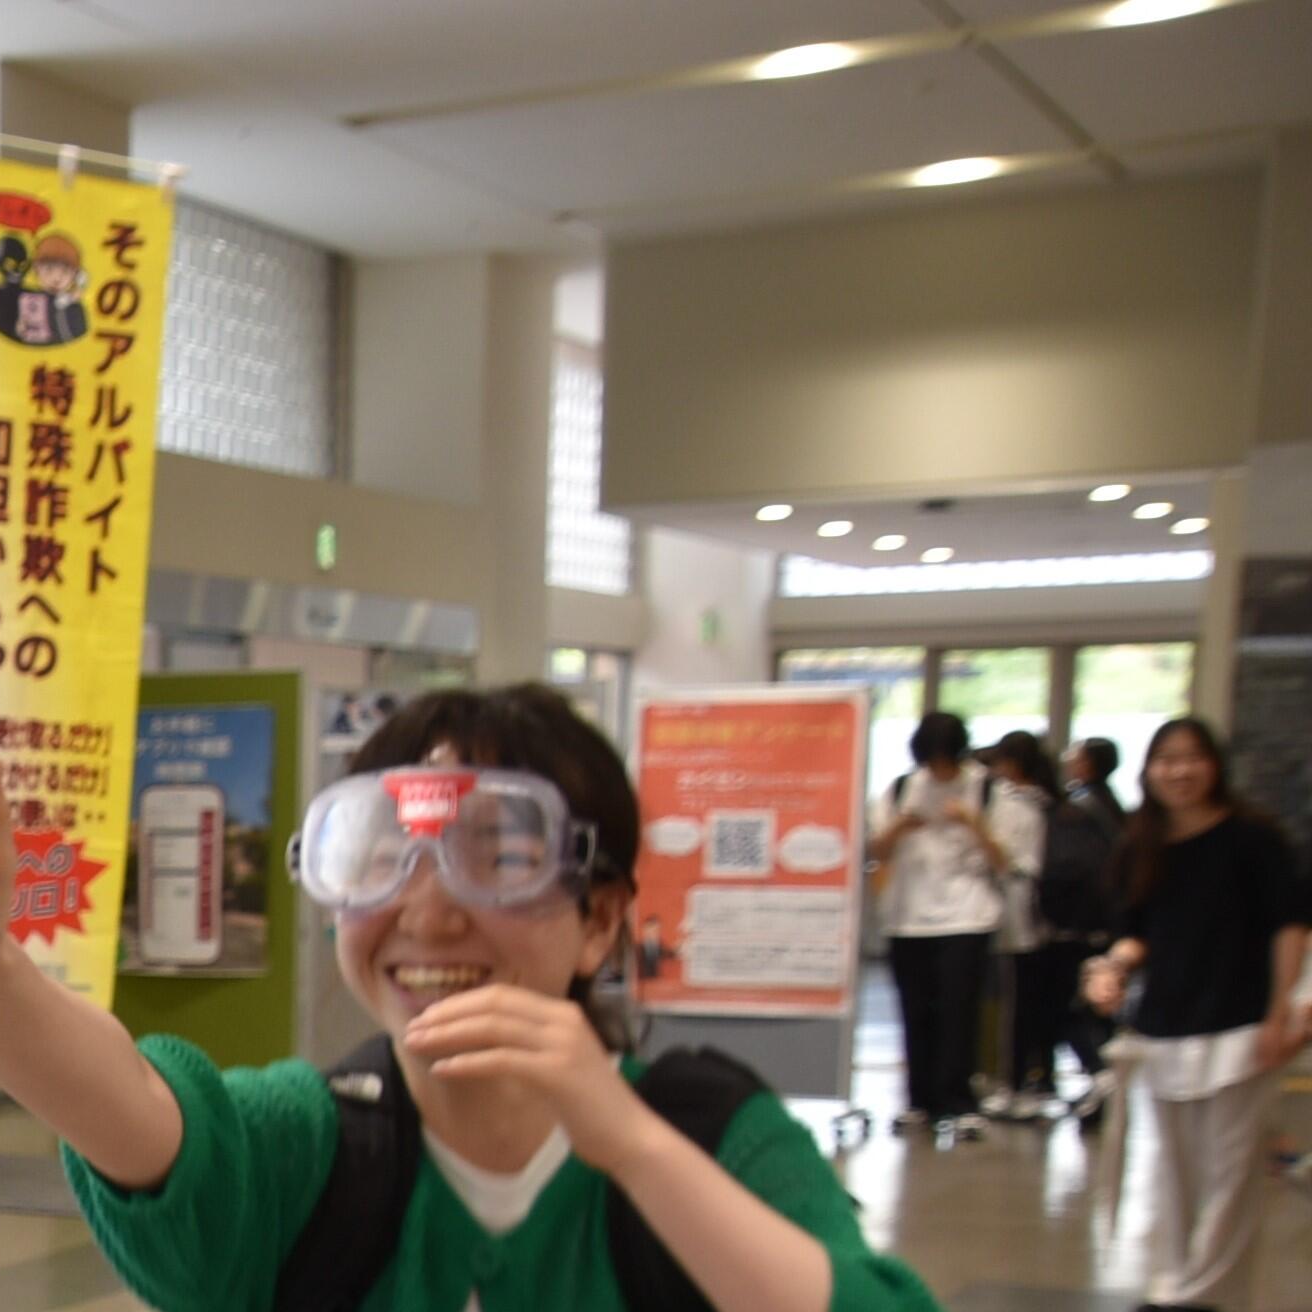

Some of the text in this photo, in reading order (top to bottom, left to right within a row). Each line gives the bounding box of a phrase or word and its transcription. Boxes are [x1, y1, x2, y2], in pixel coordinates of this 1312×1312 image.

[14, 362, 76, 680] 特殊詐欺への
[84, 220, 145, 595] そのアルバイト
